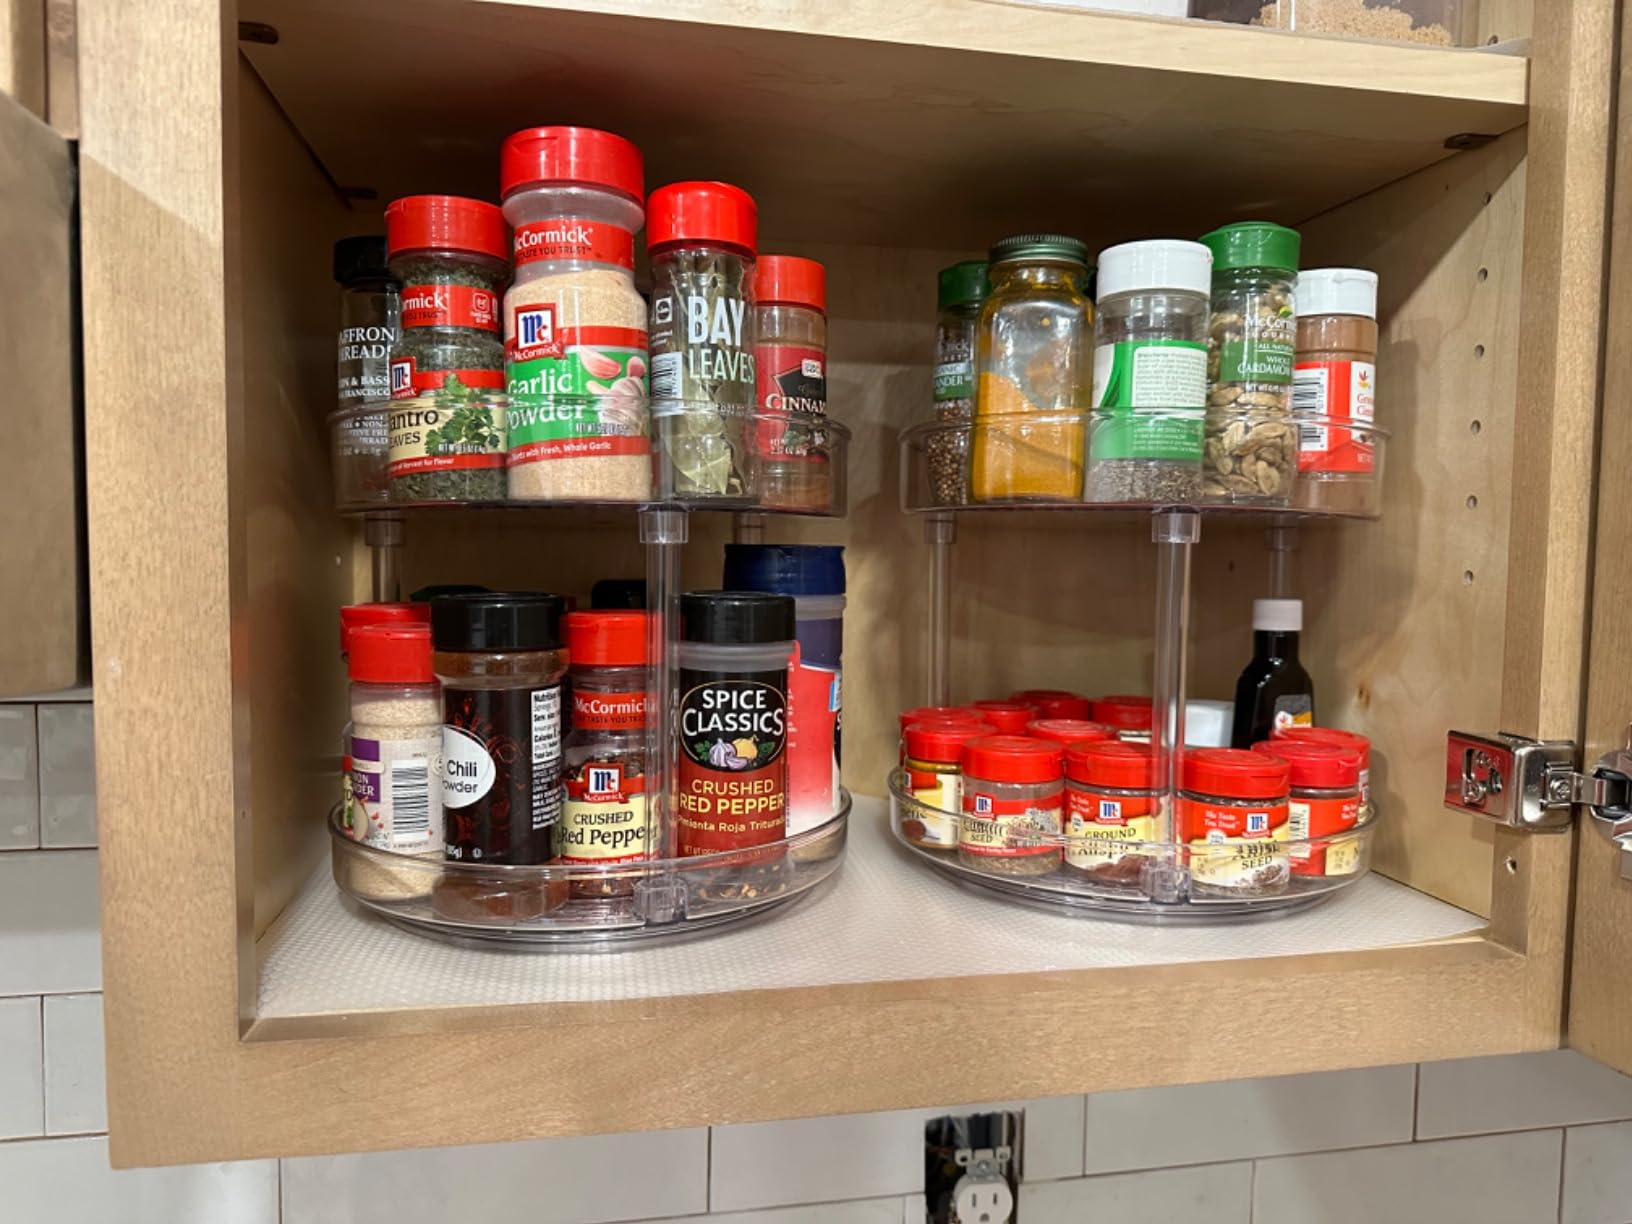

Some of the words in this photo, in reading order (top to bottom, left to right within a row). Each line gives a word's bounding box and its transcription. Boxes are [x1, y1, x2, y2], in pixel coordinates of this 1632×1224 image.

[687, 296, 745, 346] BAY
[689, 348, 755, 384] LEAVES
[506, 398, 584, 430] owder
[703, 690, 767, 709] SPICE
[683, 708, 784, 736] CLASSICS
[446, 759, 477, 777] Chili
[692, 779, 774, 796] CRUSHED
[680, 792, 711, 813] RED
[717, 792, 785, 815] PEPPER
[574, 811, 633, 826] CRUSHED
[719, 822, 746, 834] Roja
[1084, 827, 1137, 840] GROUND
